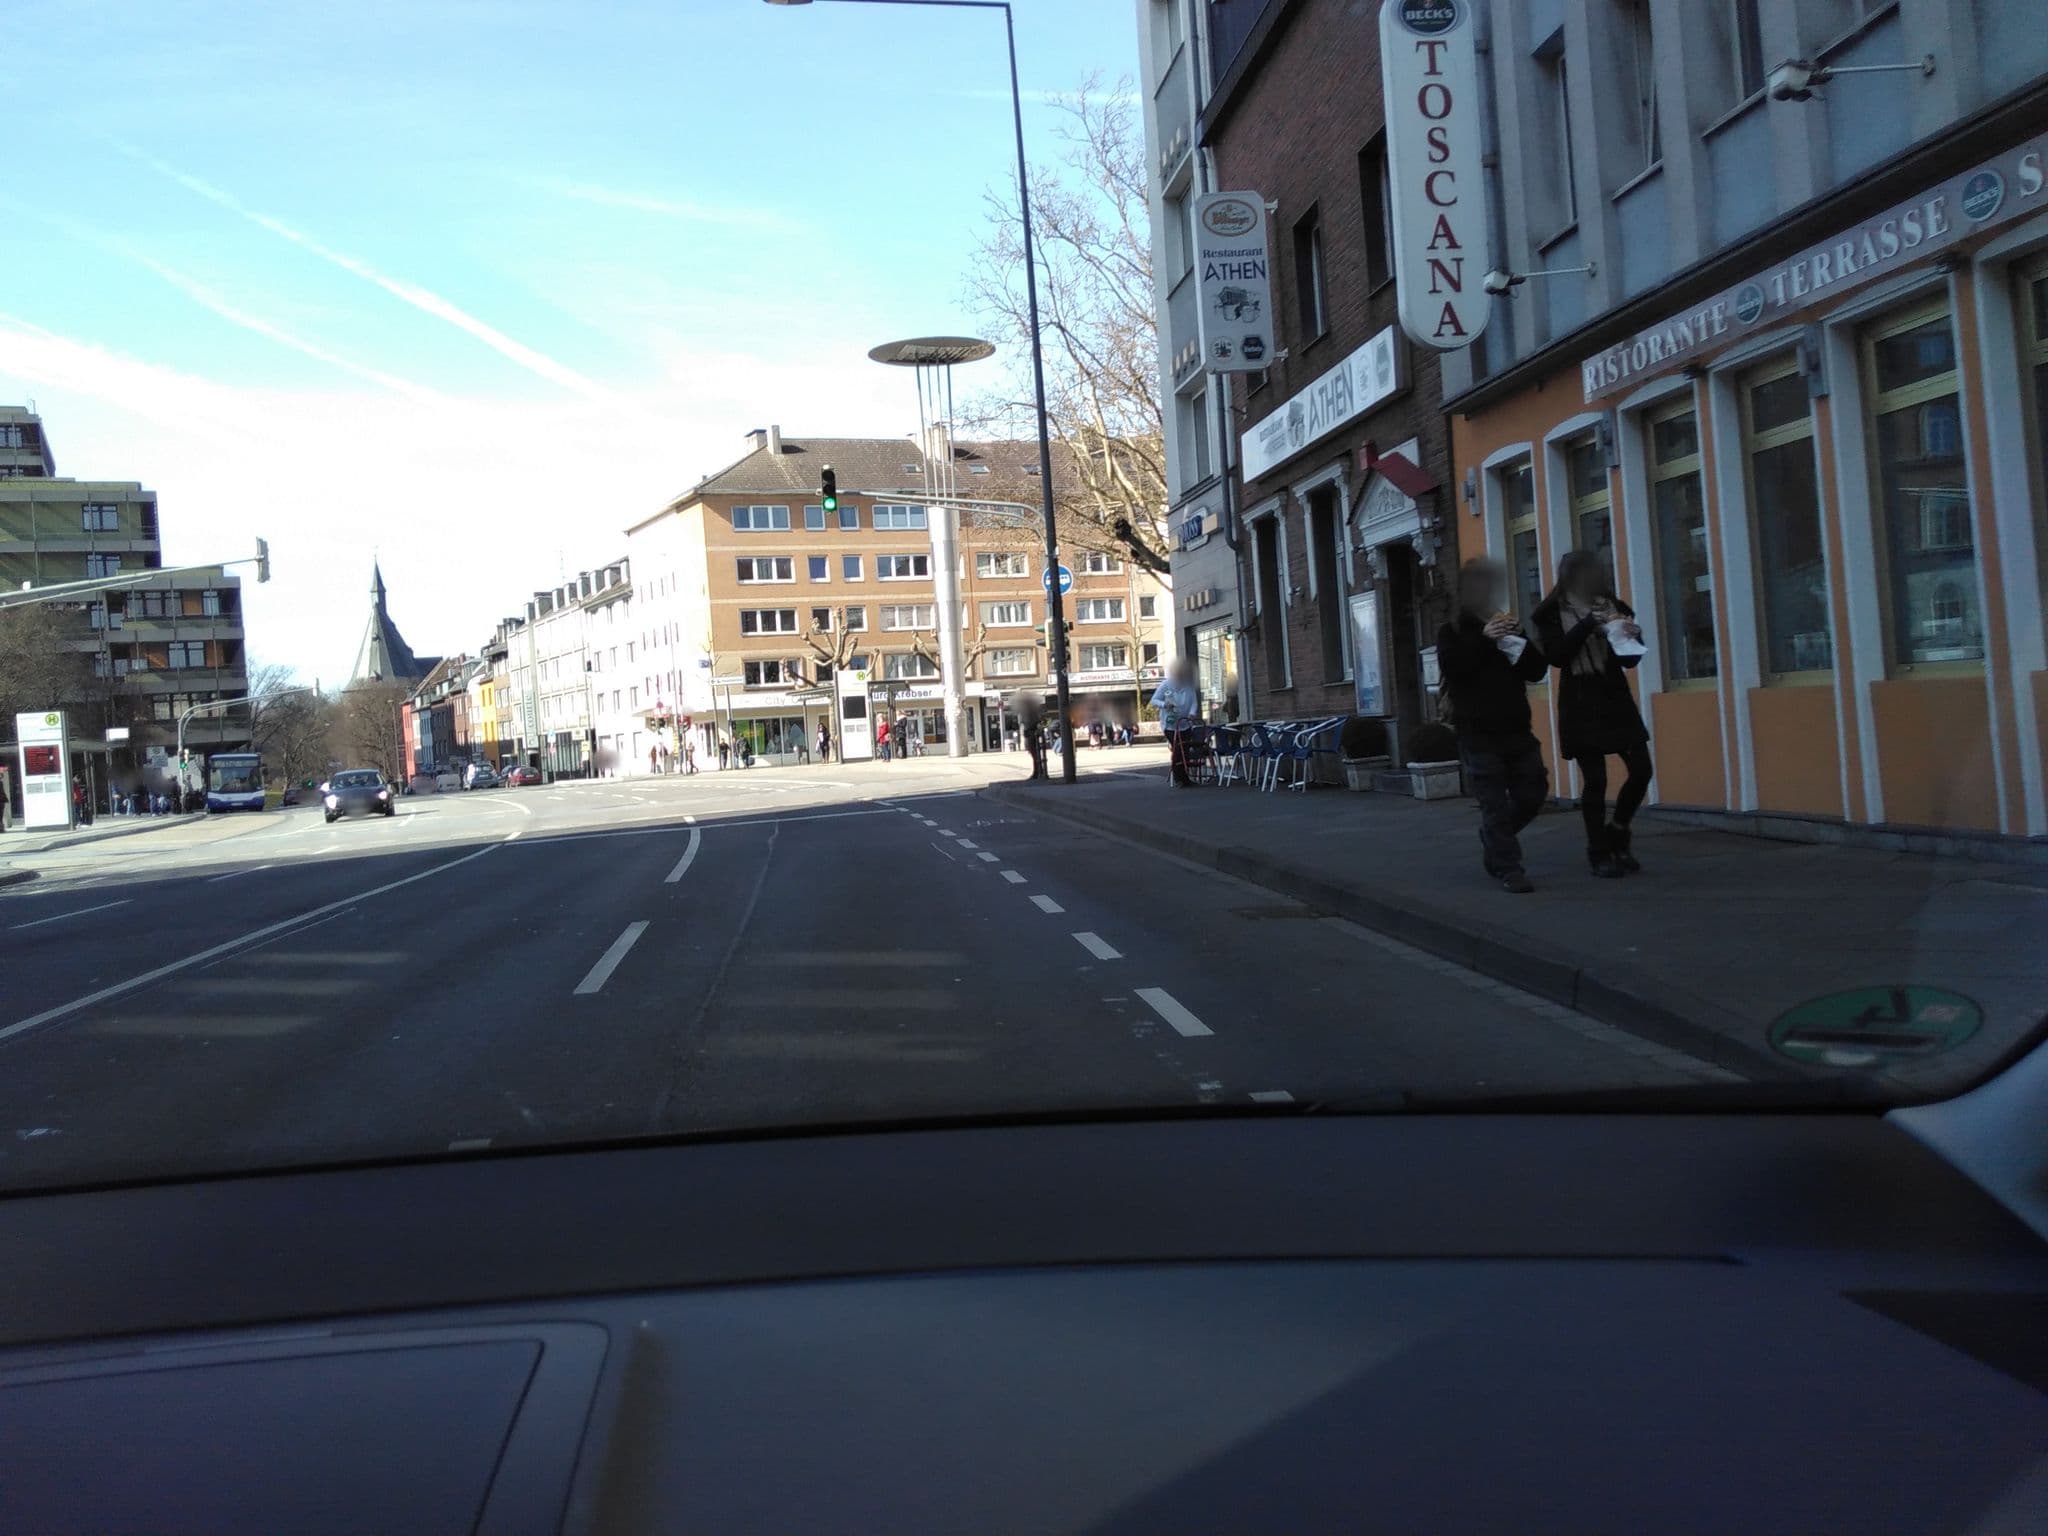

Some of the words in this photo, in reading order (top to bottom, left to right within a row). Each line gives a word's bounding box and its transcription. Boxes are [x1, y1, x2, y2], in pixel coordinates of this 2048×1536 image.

[1415, 40, 1468, 338] TOSCANA
[1203, 248, 1263, 258] Restaurant
[1203, 260, 1267, 282] ATHEN
[1584, 301, 1728, 394] RISTORANTE
[1771, 195, 1951, 309] TERRASSE
[1309, 361, 1355, 438] ATHEN
